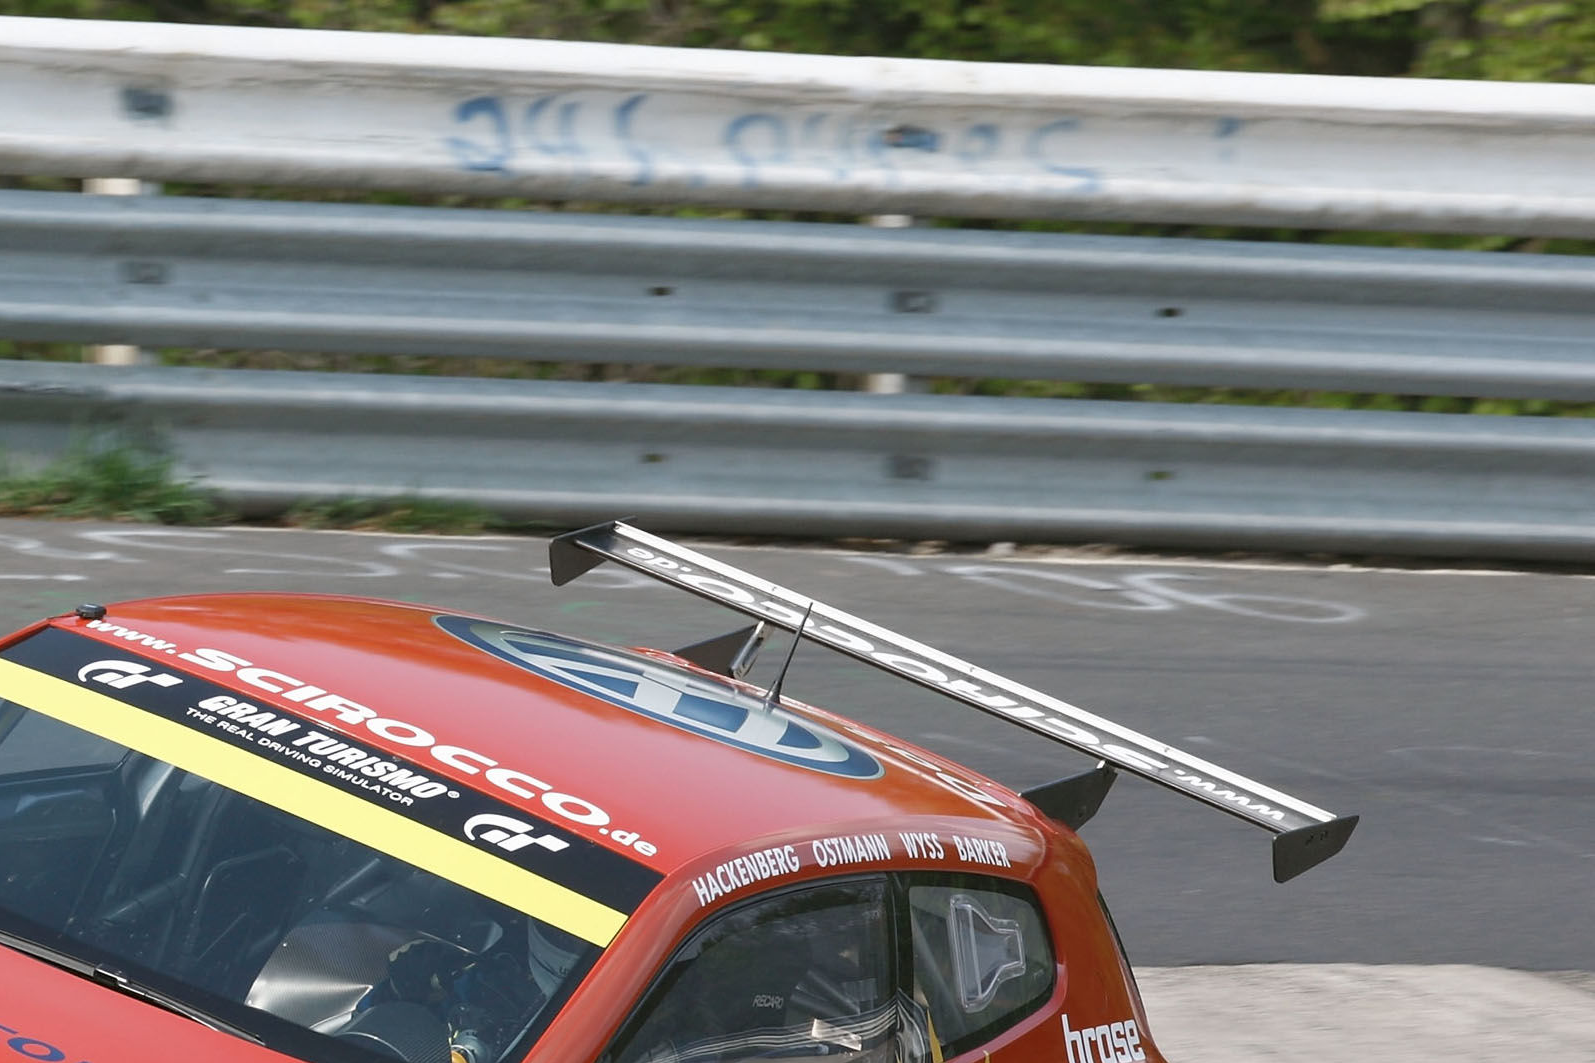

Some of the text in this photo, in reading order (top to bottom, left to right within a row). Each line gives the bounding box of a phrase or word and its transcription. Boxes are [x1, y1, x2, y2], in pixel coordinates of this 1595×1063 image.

[198, 695, 301, 736] GRAN
[186, 707, 414, 806] THE REAL DRIVING SIMULATOR
[692, 832, 1011, 907] HACKENBERG OSTMANN WYSS BARKER
